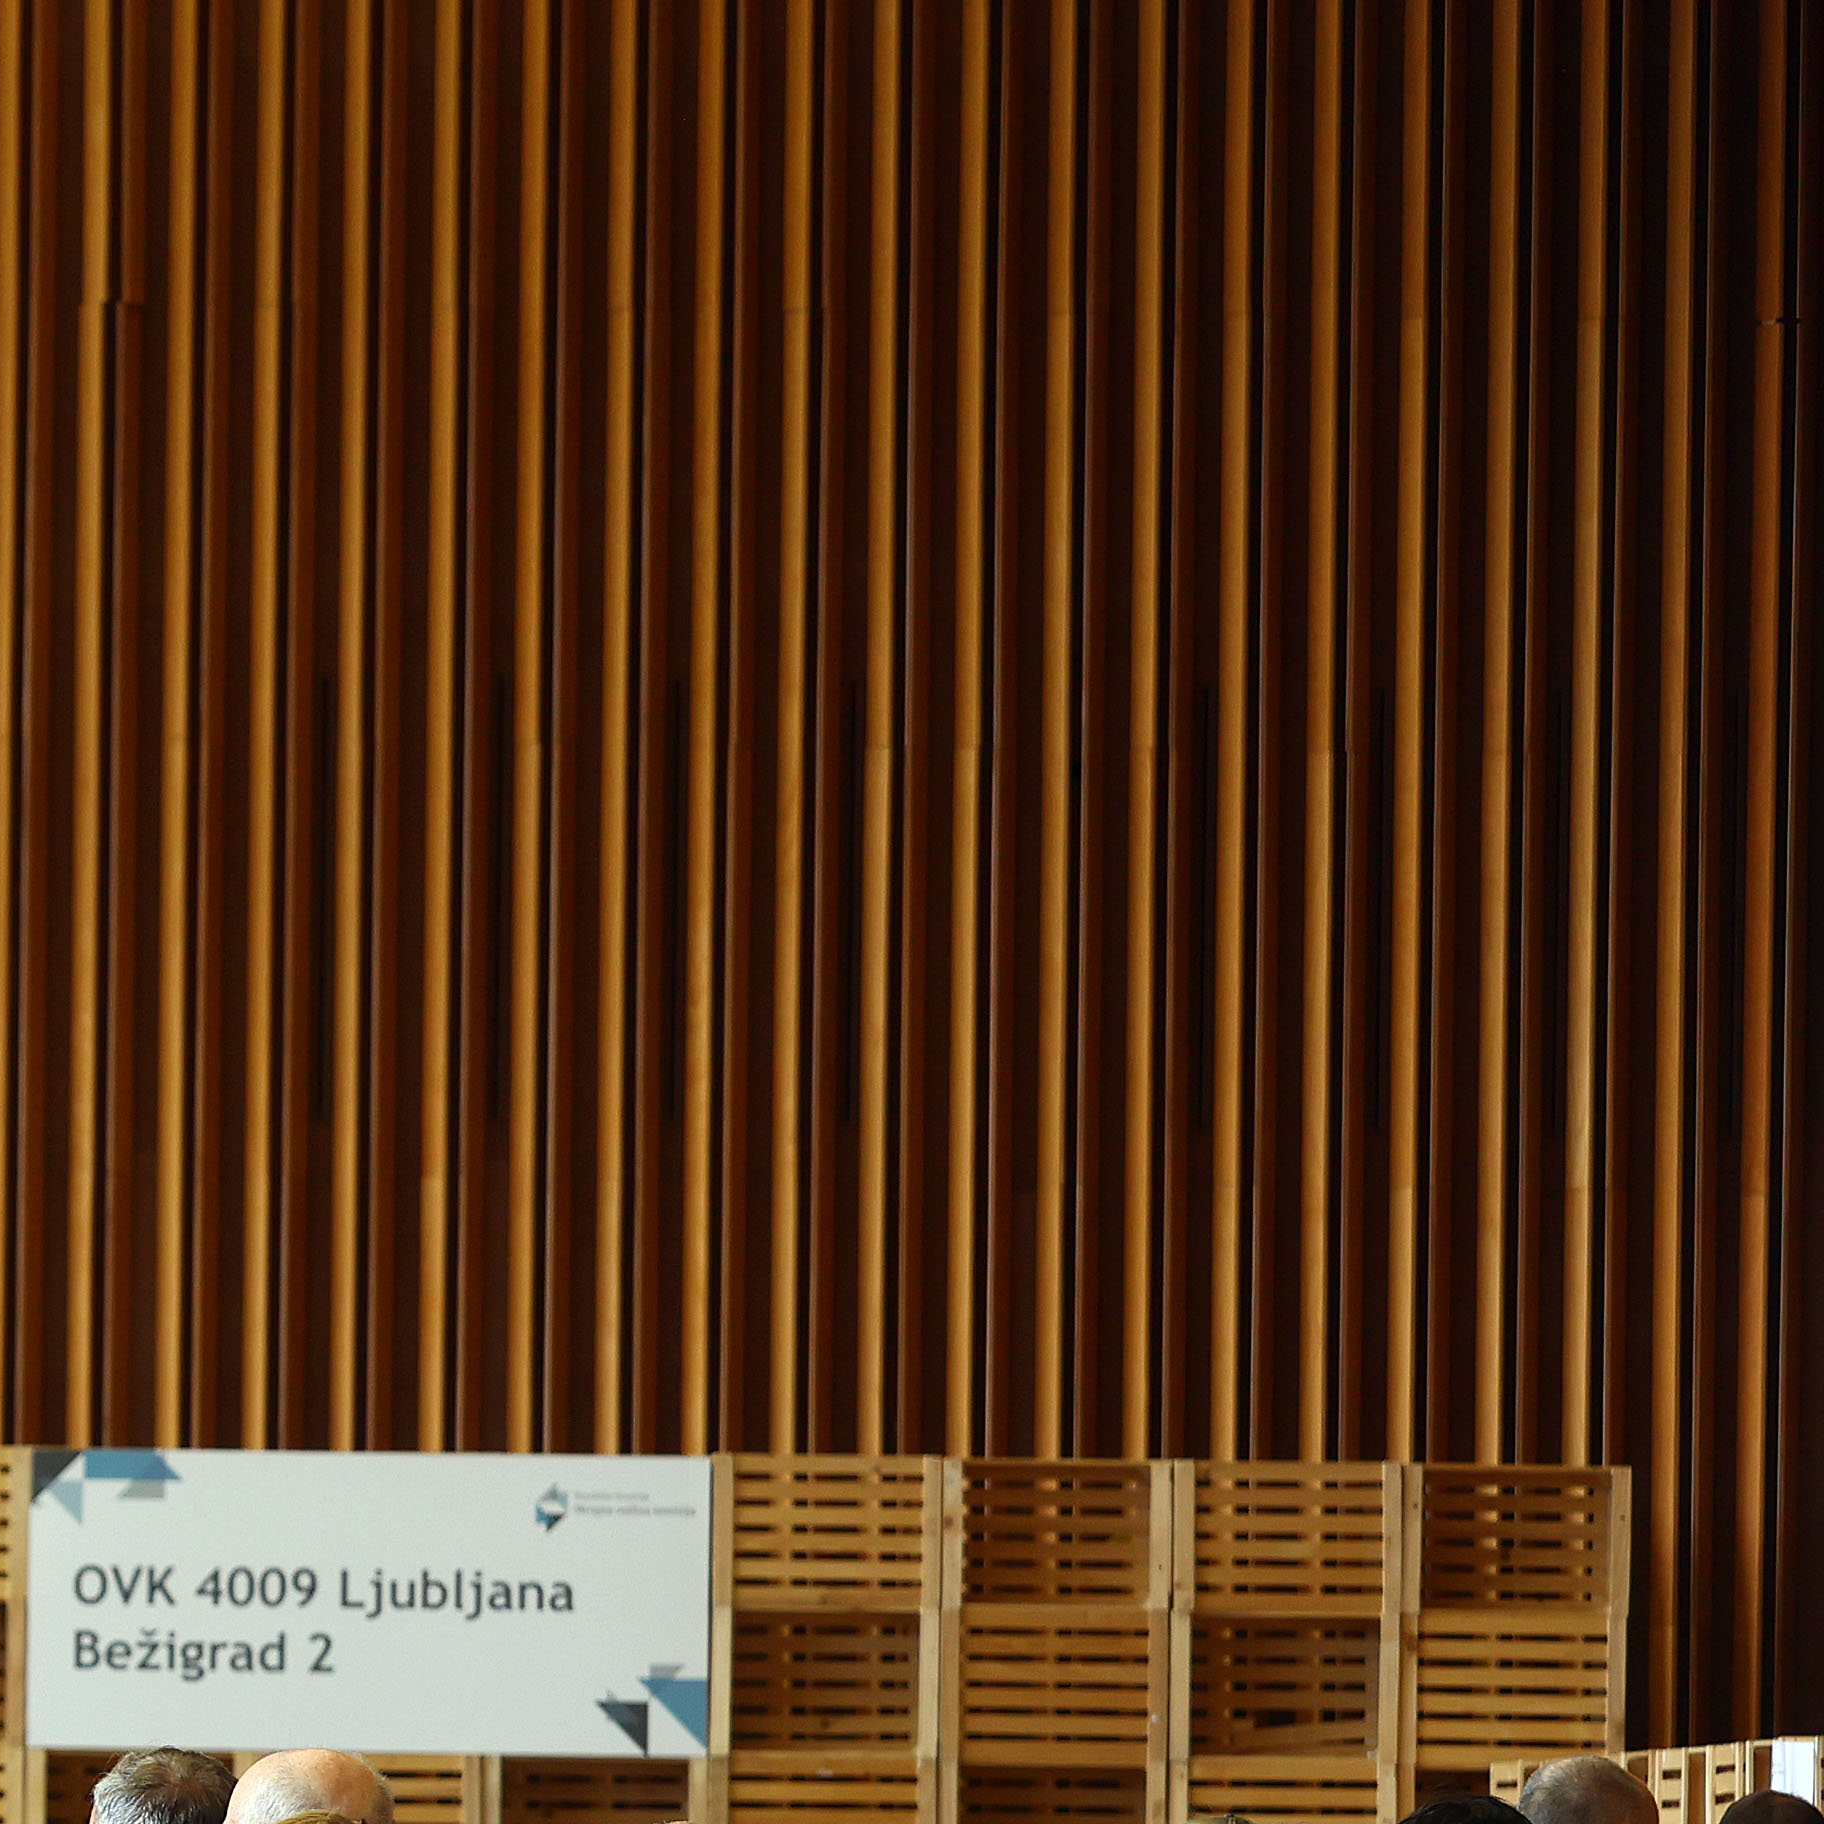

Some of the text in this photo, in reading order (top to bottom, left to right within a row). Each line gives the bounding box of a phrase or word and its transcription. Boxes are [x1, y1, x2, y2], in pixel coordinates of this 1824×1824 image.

[73, 1563, 575, 1621] OVK 4009 Ljubljana
[73, 1627, 335, 1682] Bežigrad 2
